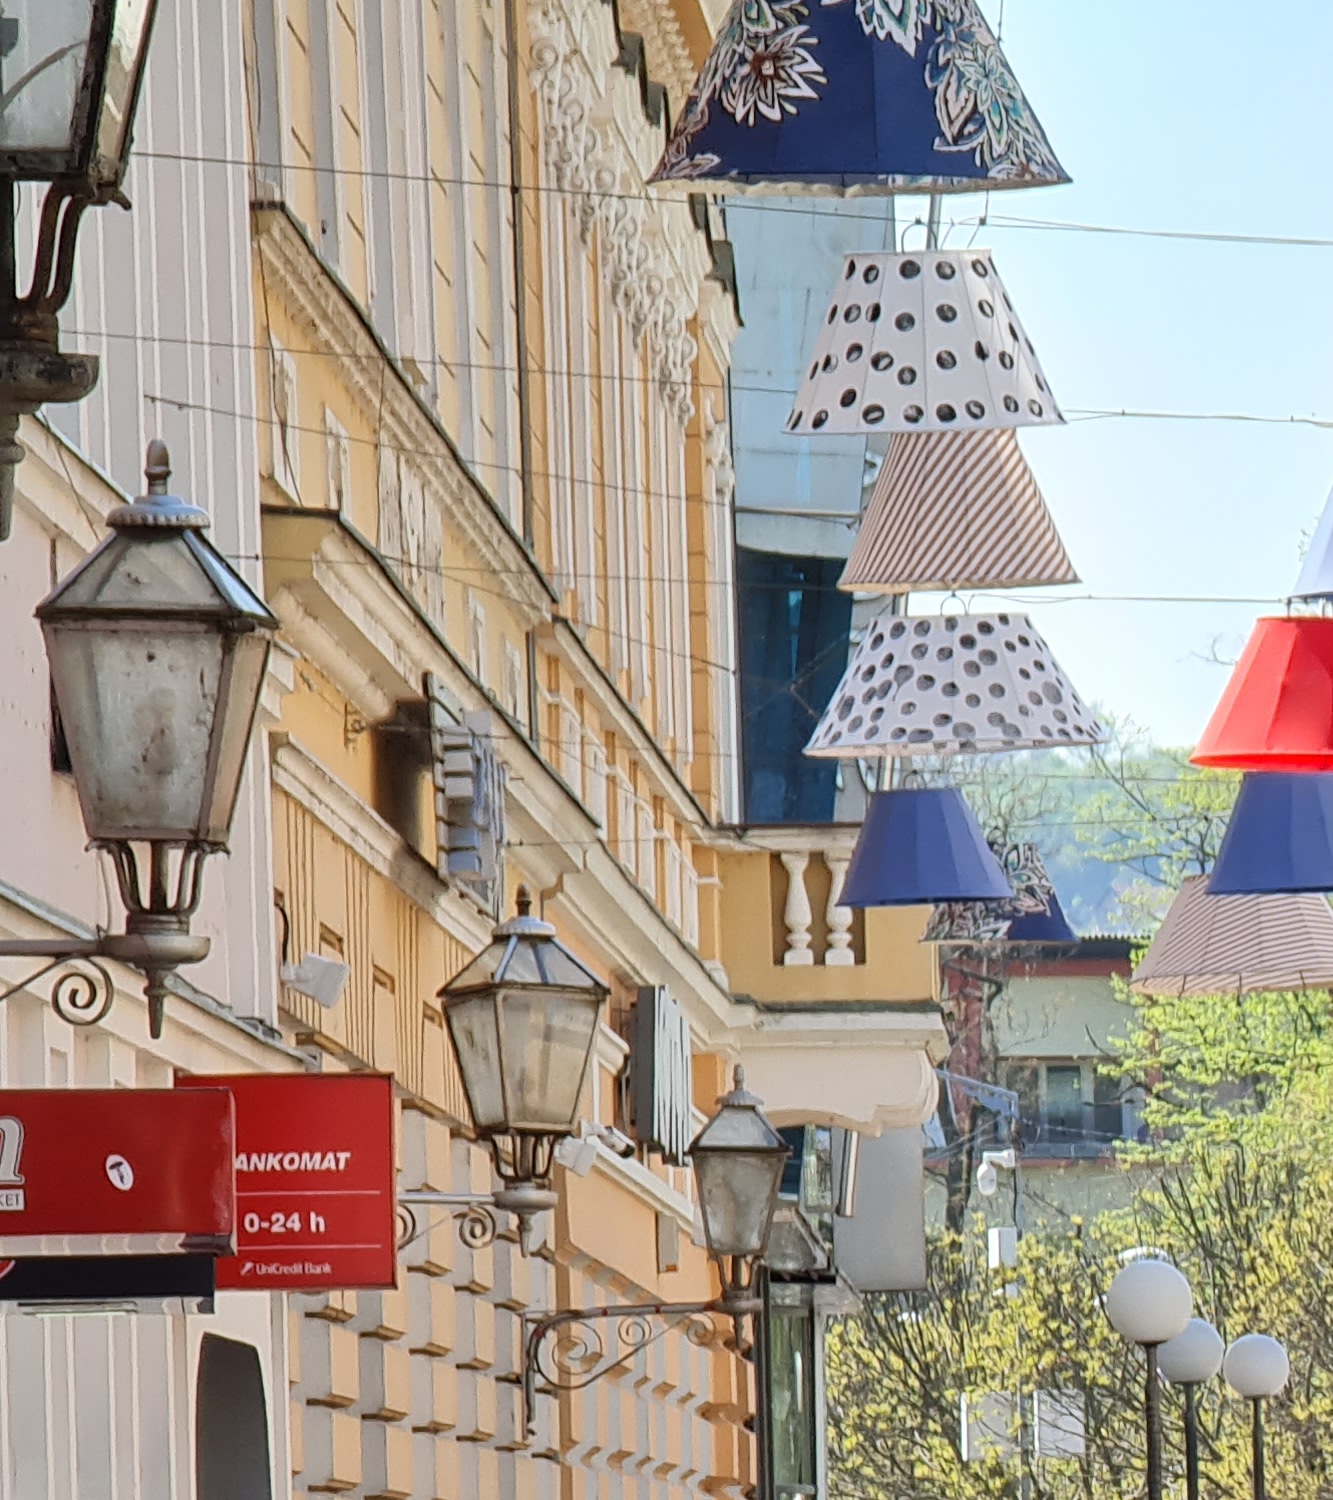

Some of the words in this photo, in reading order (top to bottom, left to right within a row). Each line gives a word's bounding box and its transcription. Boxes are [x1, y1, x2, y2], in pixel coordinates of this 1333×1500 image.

[234, 1151, 351, 1172] ANKOMAT
[244, 1212, 301, 1233] 0-24
[310, 1211, 326, 1233] h
[256, 1263, 302, 1275] UniCredit
[305, 1262, 332, 1275] Bank
